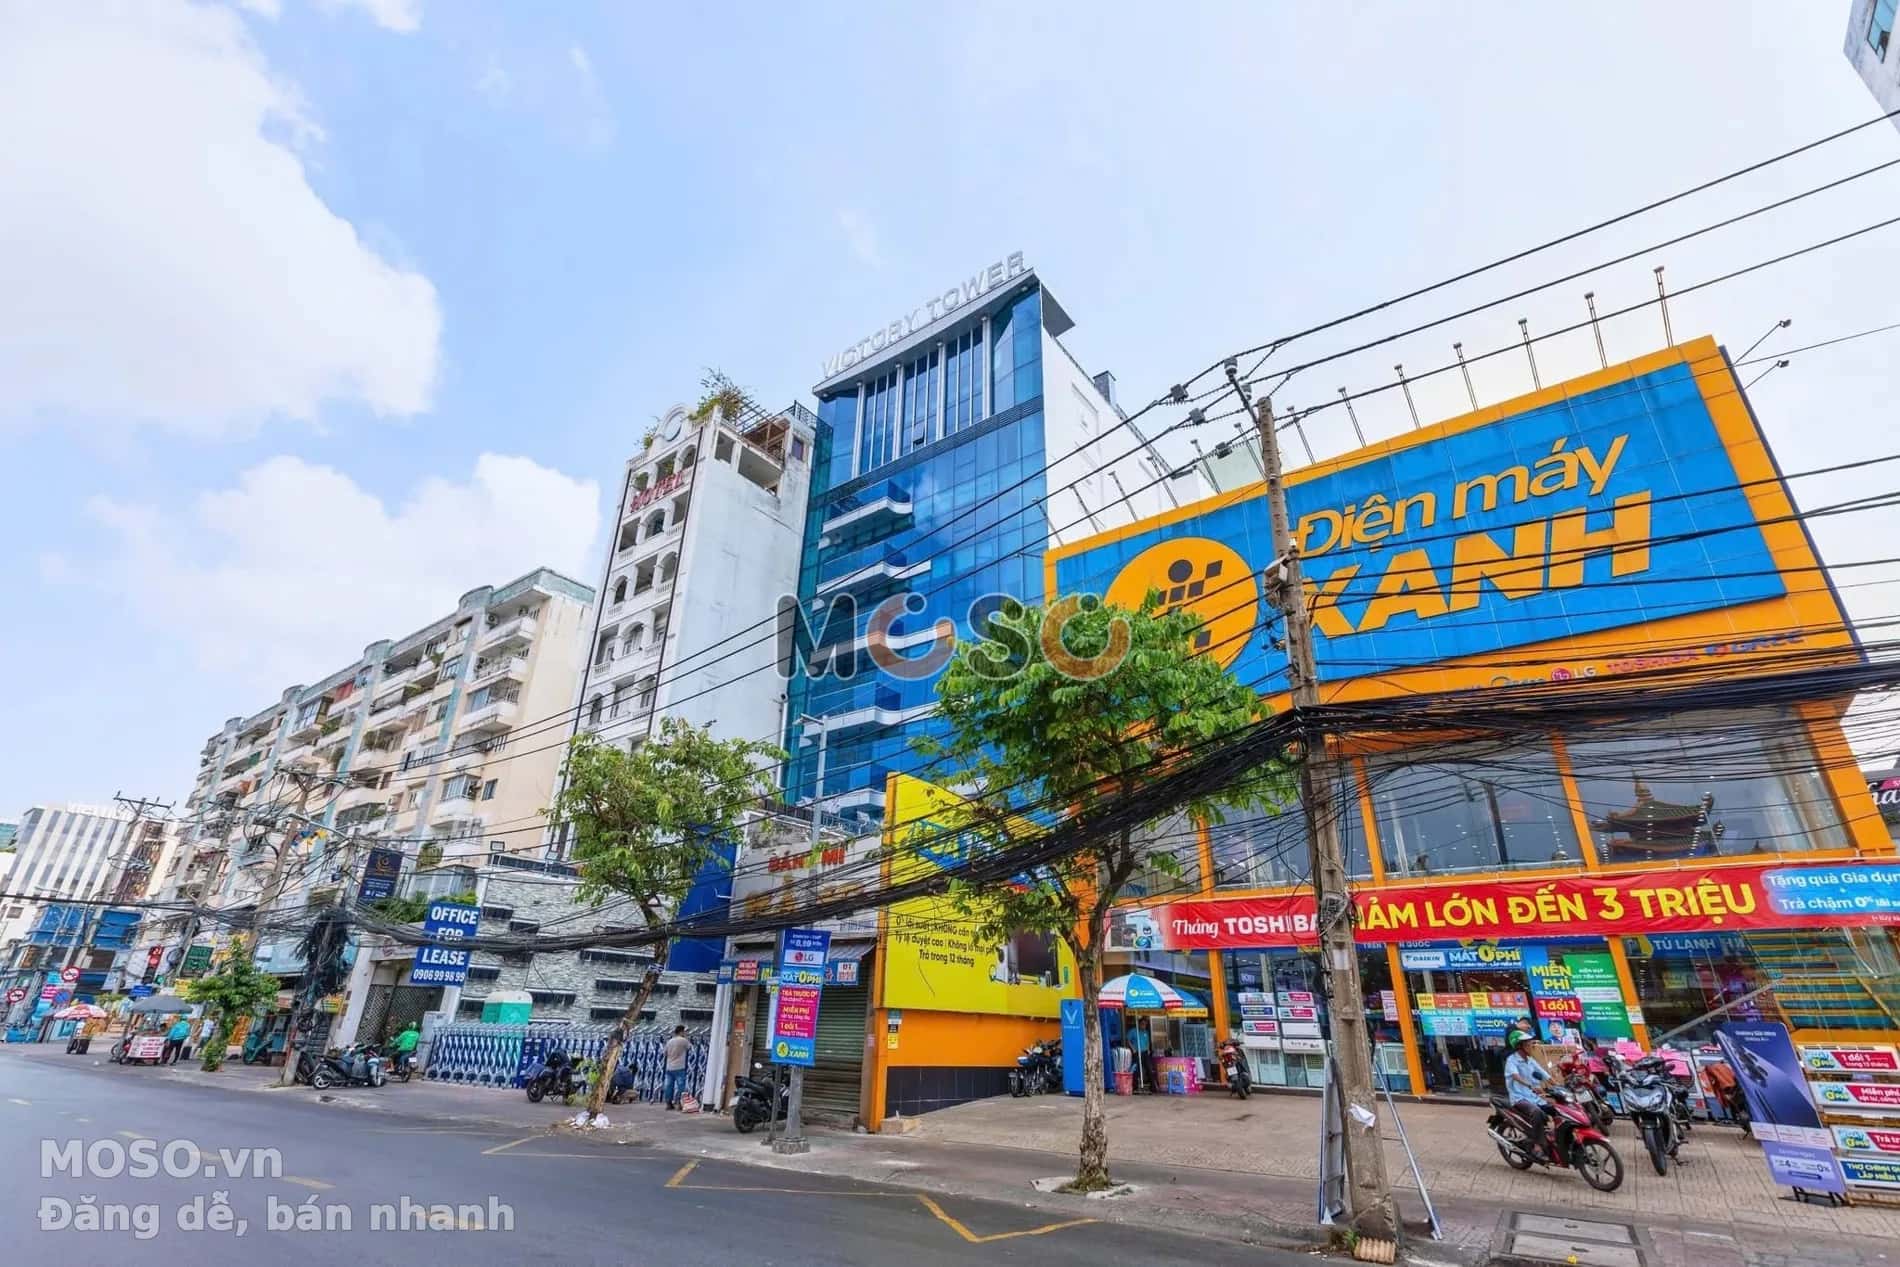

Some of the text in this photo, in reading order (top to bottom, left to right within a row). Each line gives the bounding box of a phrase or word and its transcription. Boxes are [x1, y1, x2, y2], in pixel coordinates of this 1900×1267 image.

[821, 250, 1026, 379] VICTORY TOWER
[1288, 434, 1630, 558] Điện máy
[1300, 490, 1652, 640] XANH
[1574, 666, 1596, 679] LG
[1767, 874, 1808, 889] Tặng
[1809, 872, 1839, 887] quà
[1841, 872, 1869, 883] Gia
[1171, 918, 1219, 939] Tháng
[1355, 896, 1419, 930] IẢM
[1427, 893, 1499, 928] LỚN
[1508, 882, 1588, 925] ĐẾN
[1592, 887, 1625, 921] 3
[1630, 878, 1757, 925] TRIỆU
[1780, 897, 1806, 911] Trả
[1807, 896, 1853, 912] chậm
[430, 906, 479, 925] OFFICE
[1652, 936, 1673, 951] TỦ
[1675, 939, 1716, 953] LẠNH
[421, 948, 467, 966] LEASE
[804, 953, 814, 961] LG
[1448, 949, 1478, 962] MÁT
[1531, 960, 1573, 977] MIỄN
[1542, 976, 1571, 990] PHÍ
[1539, 1000, 1548, 1011] 1
[1547, 998, 1569, 1011] đổi
[1568, 1000, 1578, 1011] 1
